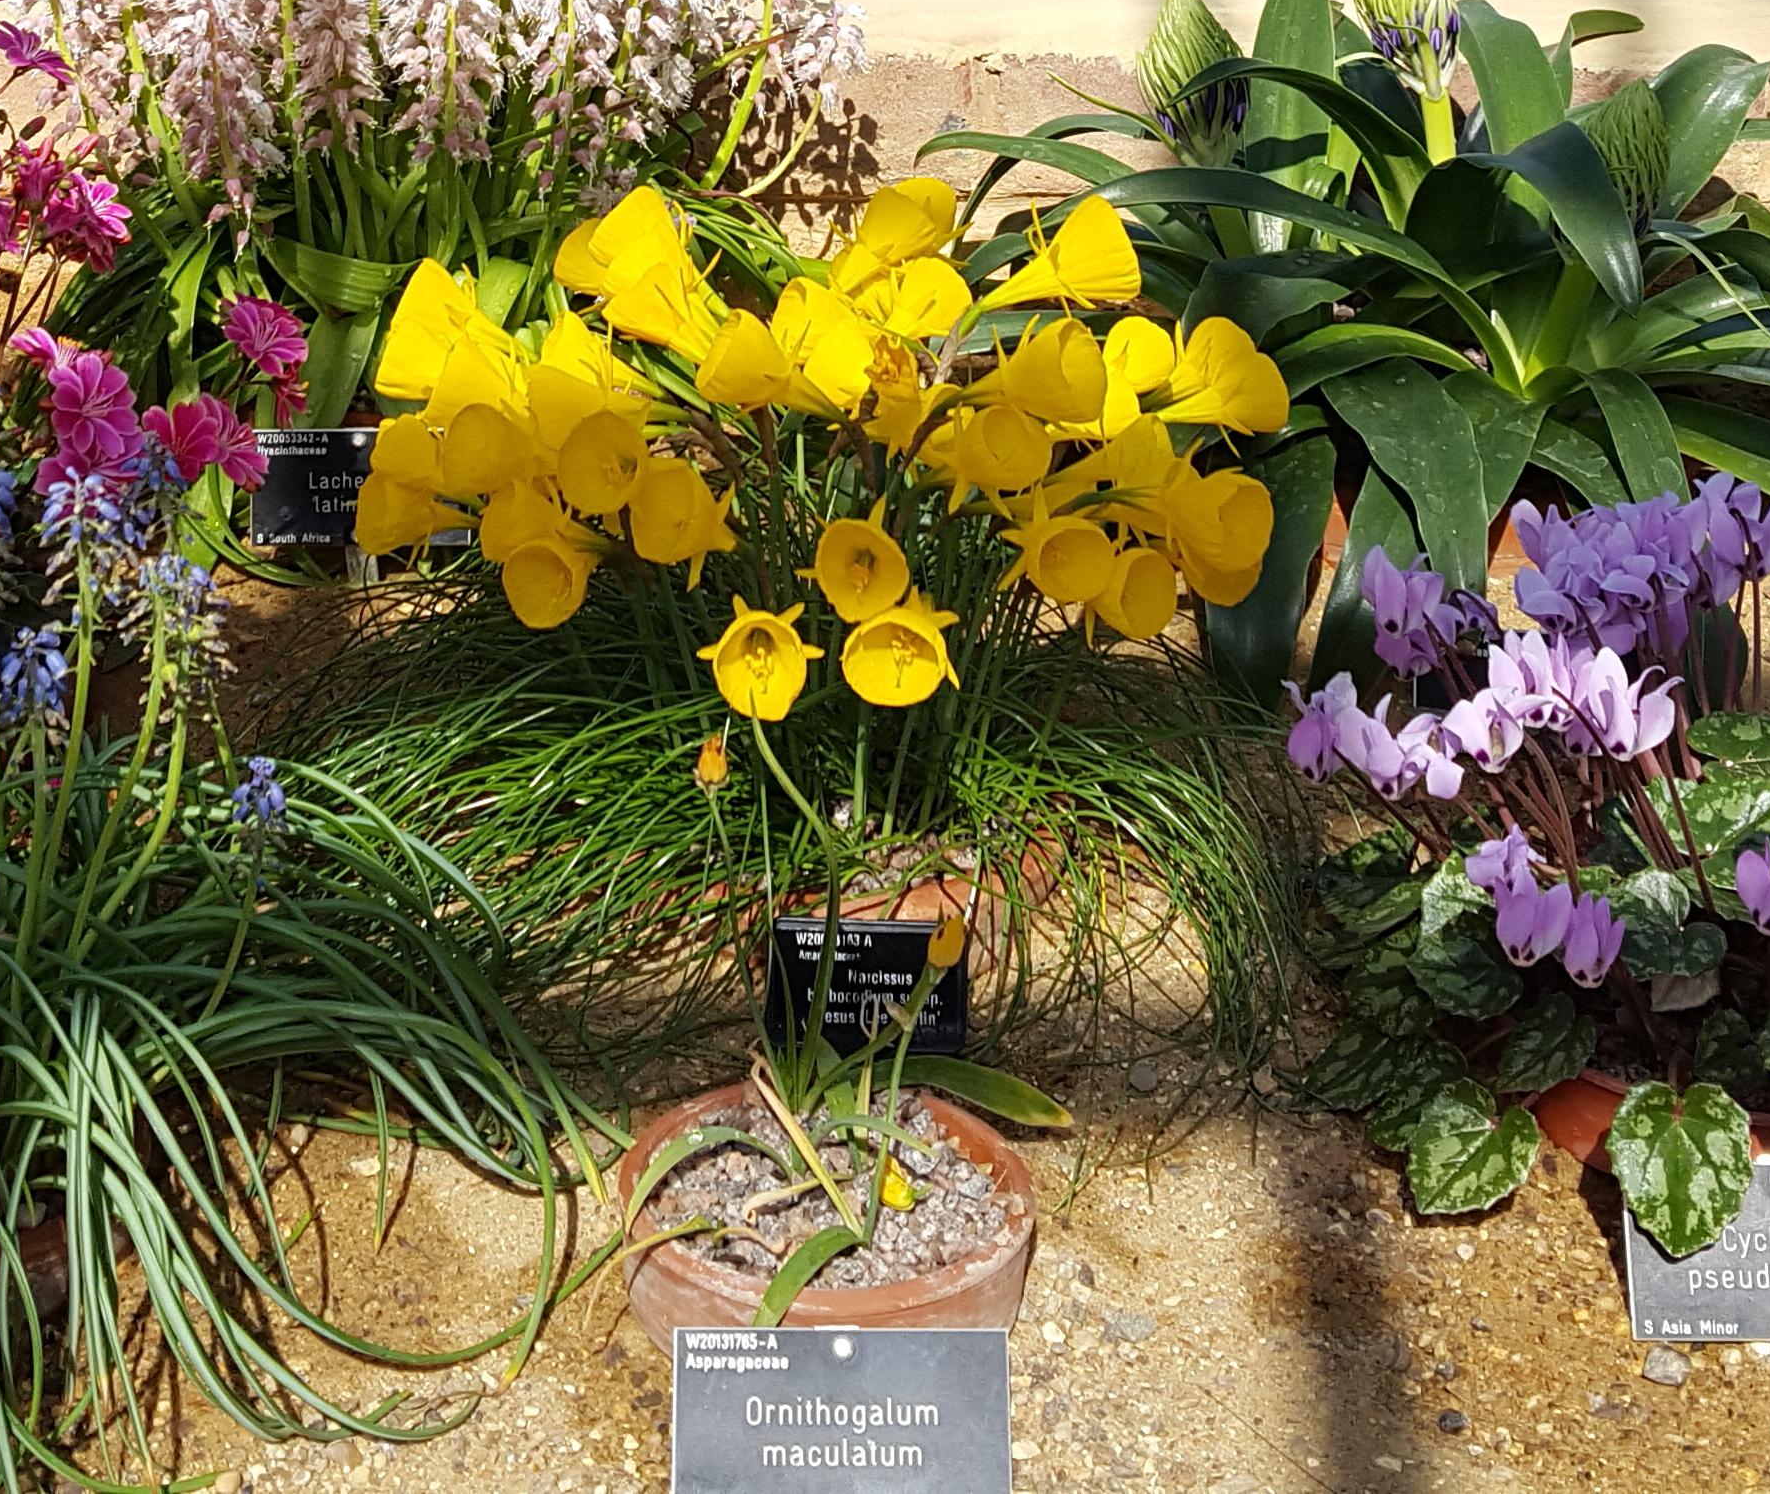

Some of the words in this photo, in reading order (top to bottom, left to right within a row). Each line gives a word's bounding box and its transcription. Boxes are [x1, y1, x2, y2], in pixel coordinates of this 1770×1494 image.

[848, 968, 913, 986] Narcissus
[1644, 1319, 1654, 1334] S
[1661, 1319, 1692, 1335] Asia
[1699, 1319, 1739, 1335] Minor
[685, 1353, 789, 1373] Asparagaceae
[745, 1396, 939, 1434] Ornithogalum
[762, 1438, 923, 1467] maculatum
